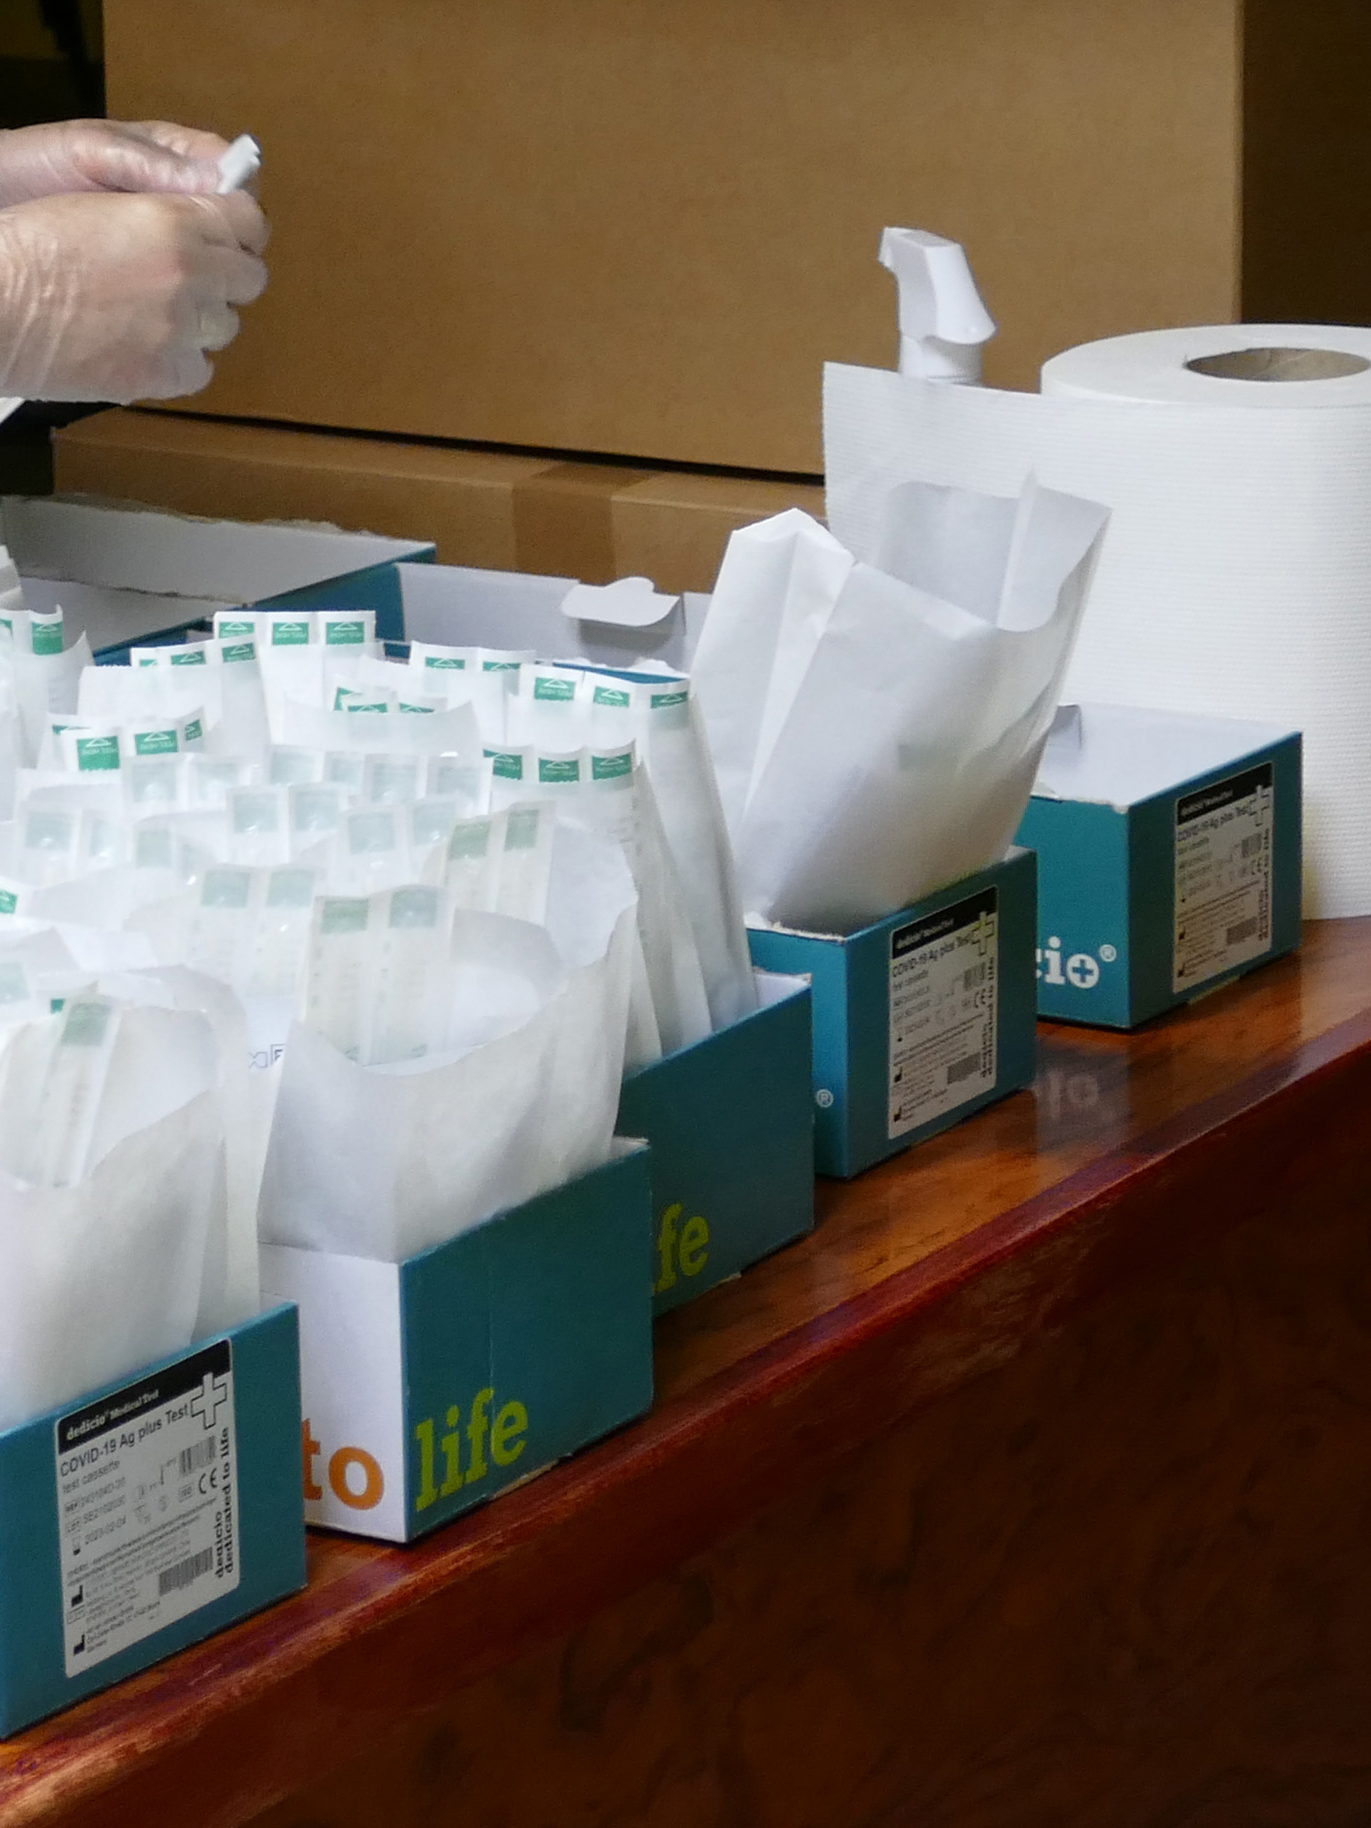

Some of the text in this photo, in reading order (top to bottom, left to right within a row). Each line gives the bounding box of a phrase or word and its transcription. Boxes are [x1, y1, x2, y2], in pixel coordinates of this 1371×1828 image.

[60, 1402, 189, 1478] COVID-19 Ag plus Test
[302, 1418, 385, 1511] to
[415, 1387, 528, 1512] life
[222, 1484, 234, 1574] dedicated
